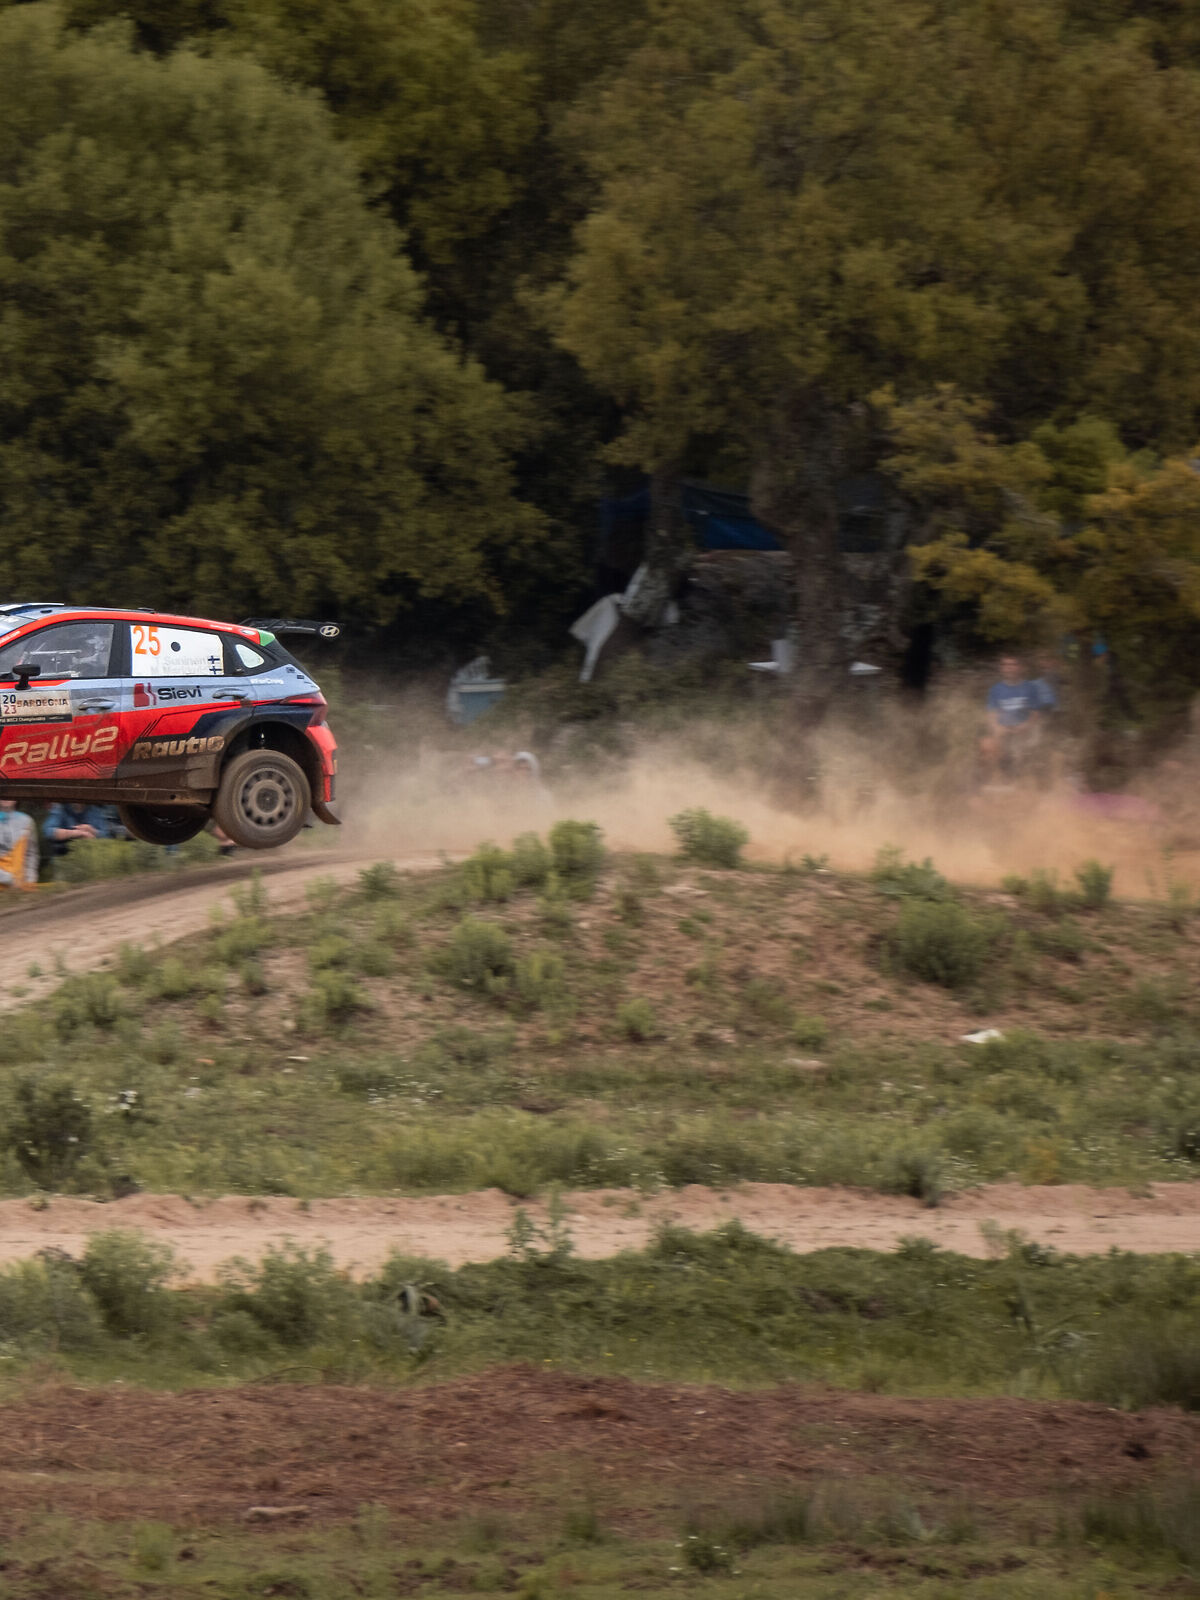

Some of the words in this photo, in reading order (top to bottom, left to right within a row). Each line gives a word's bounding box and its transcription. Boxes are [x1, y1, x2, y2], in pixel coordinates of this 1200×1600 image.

[133, 625, 161, 656] 25
[2, 694, 16, 704] 20
[157, 685, 202, 700] Sievi
[4, 704, 17, 715] 23
[16, 698, 69, 708] SARDEGNA
[132, 735, 225, 761] Rautio
